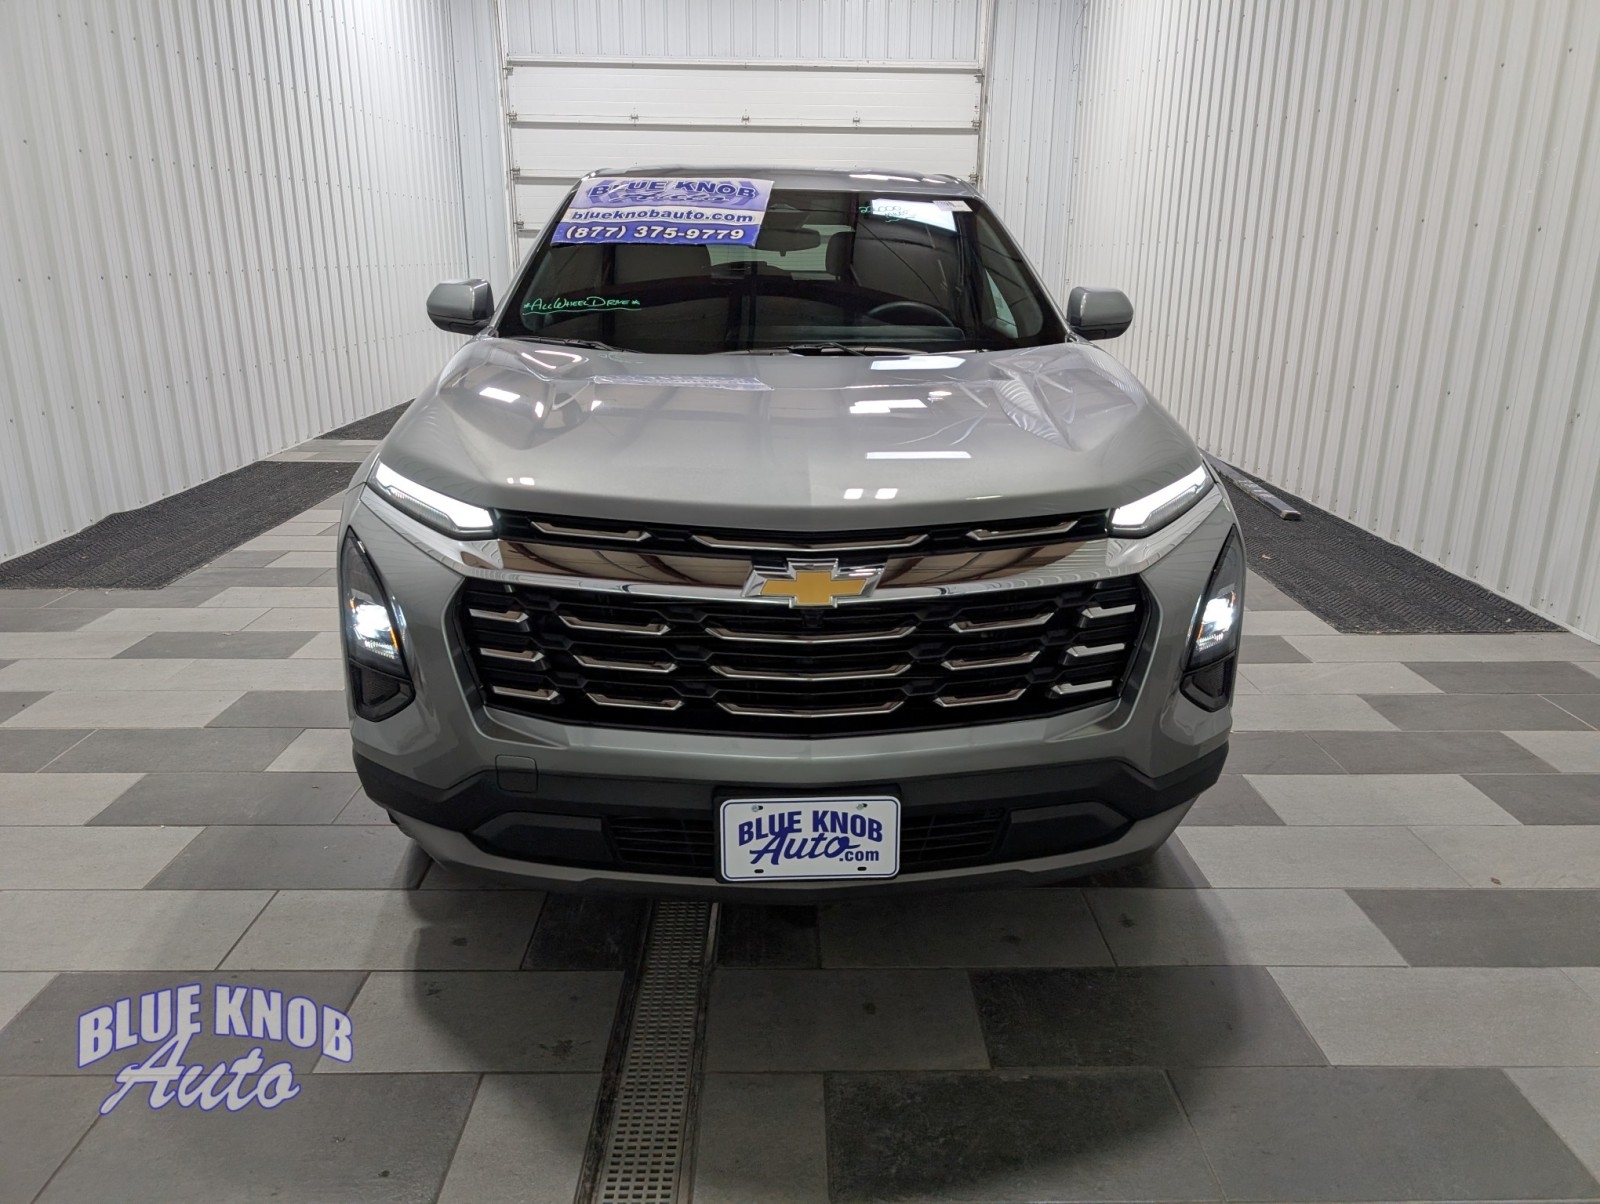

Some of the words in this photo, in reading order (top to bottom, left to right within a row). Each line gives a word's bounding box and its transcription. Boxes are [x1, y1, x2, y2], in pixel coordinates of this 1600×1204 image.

[590, 181, 668, 196] BLUE
[674, 181, 756, 199] KNOB
[571, 209, 753, 223] blueknobauto.com
[566, 226, 627, 239] (877)
[633, 226, 745, 240] 375-9779
[738, 810, 802, 847] BLUE
[812, 810, 883, 843] KNOB
[749, 829, 861, 866] Auto
